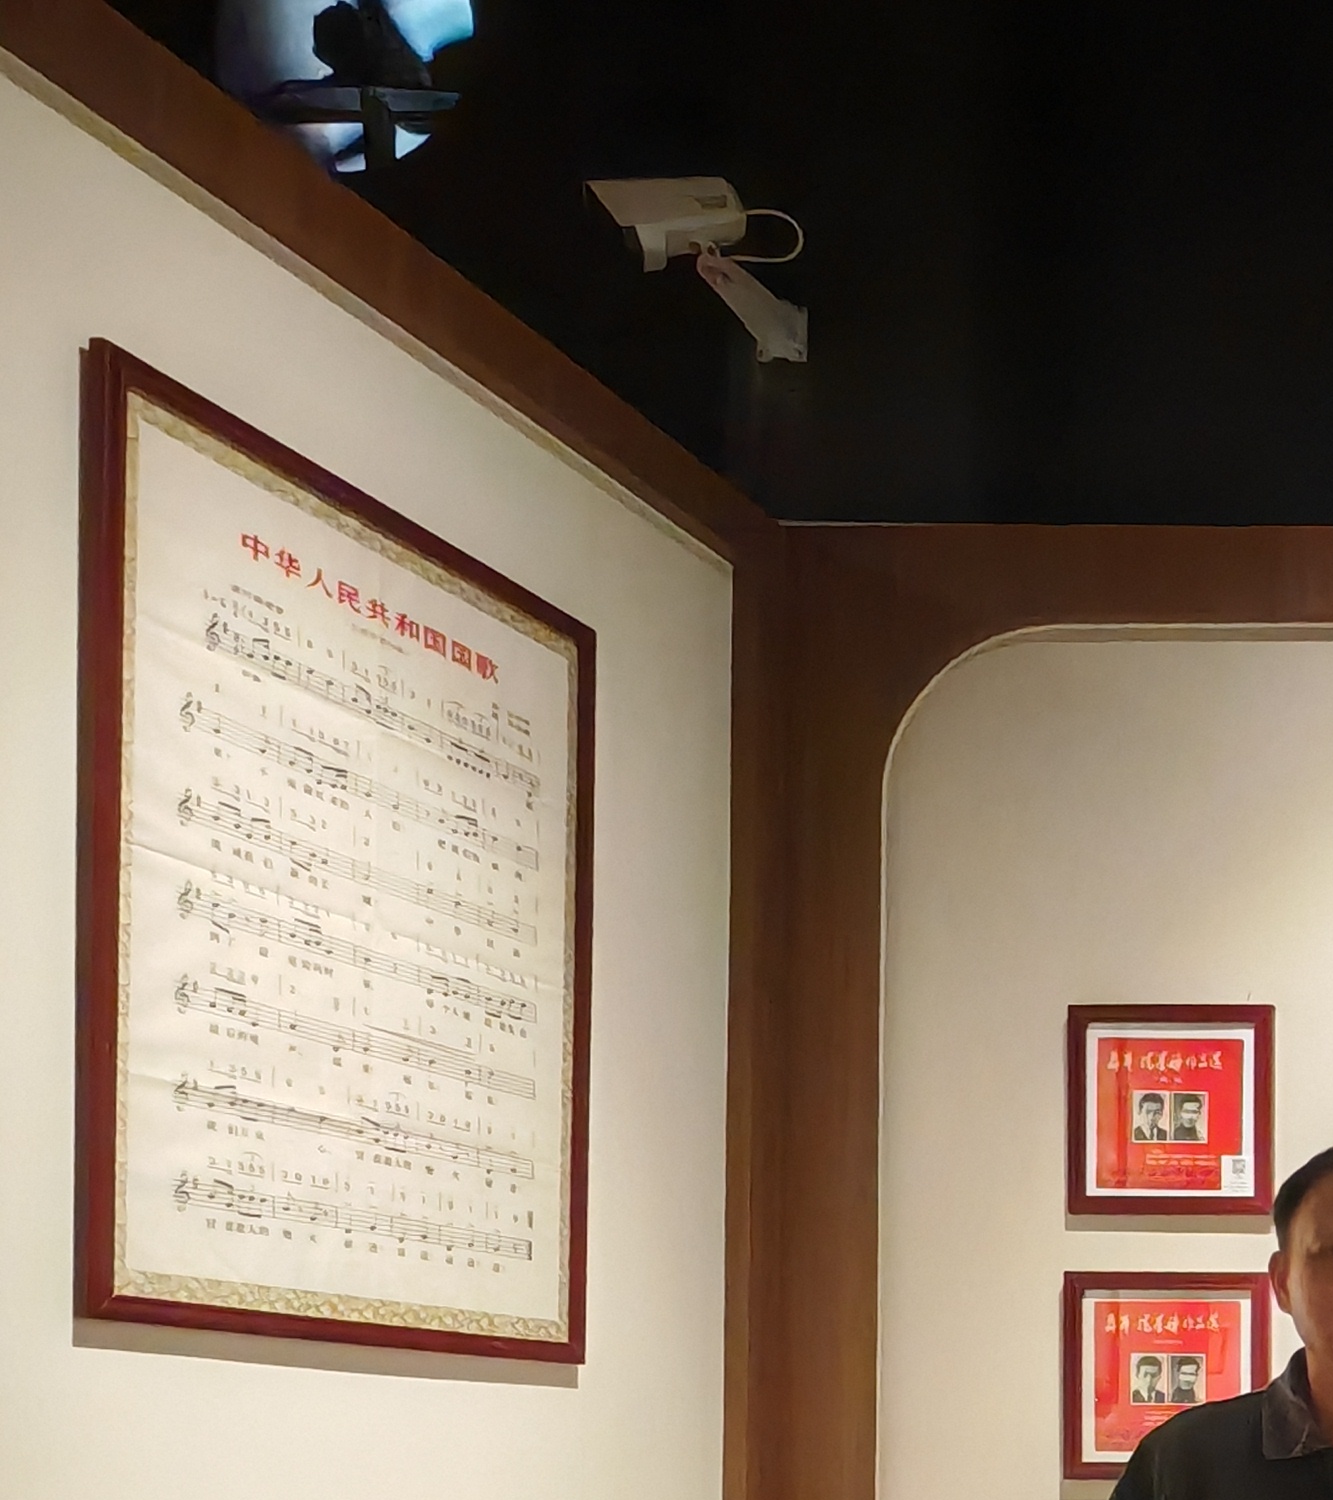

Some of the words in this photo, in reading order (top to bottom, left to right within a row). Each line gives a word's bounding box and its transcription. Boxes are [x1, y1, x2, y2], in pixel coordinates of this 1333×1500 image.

[240, 532, 500, 684] 中华人民共和国国歌
